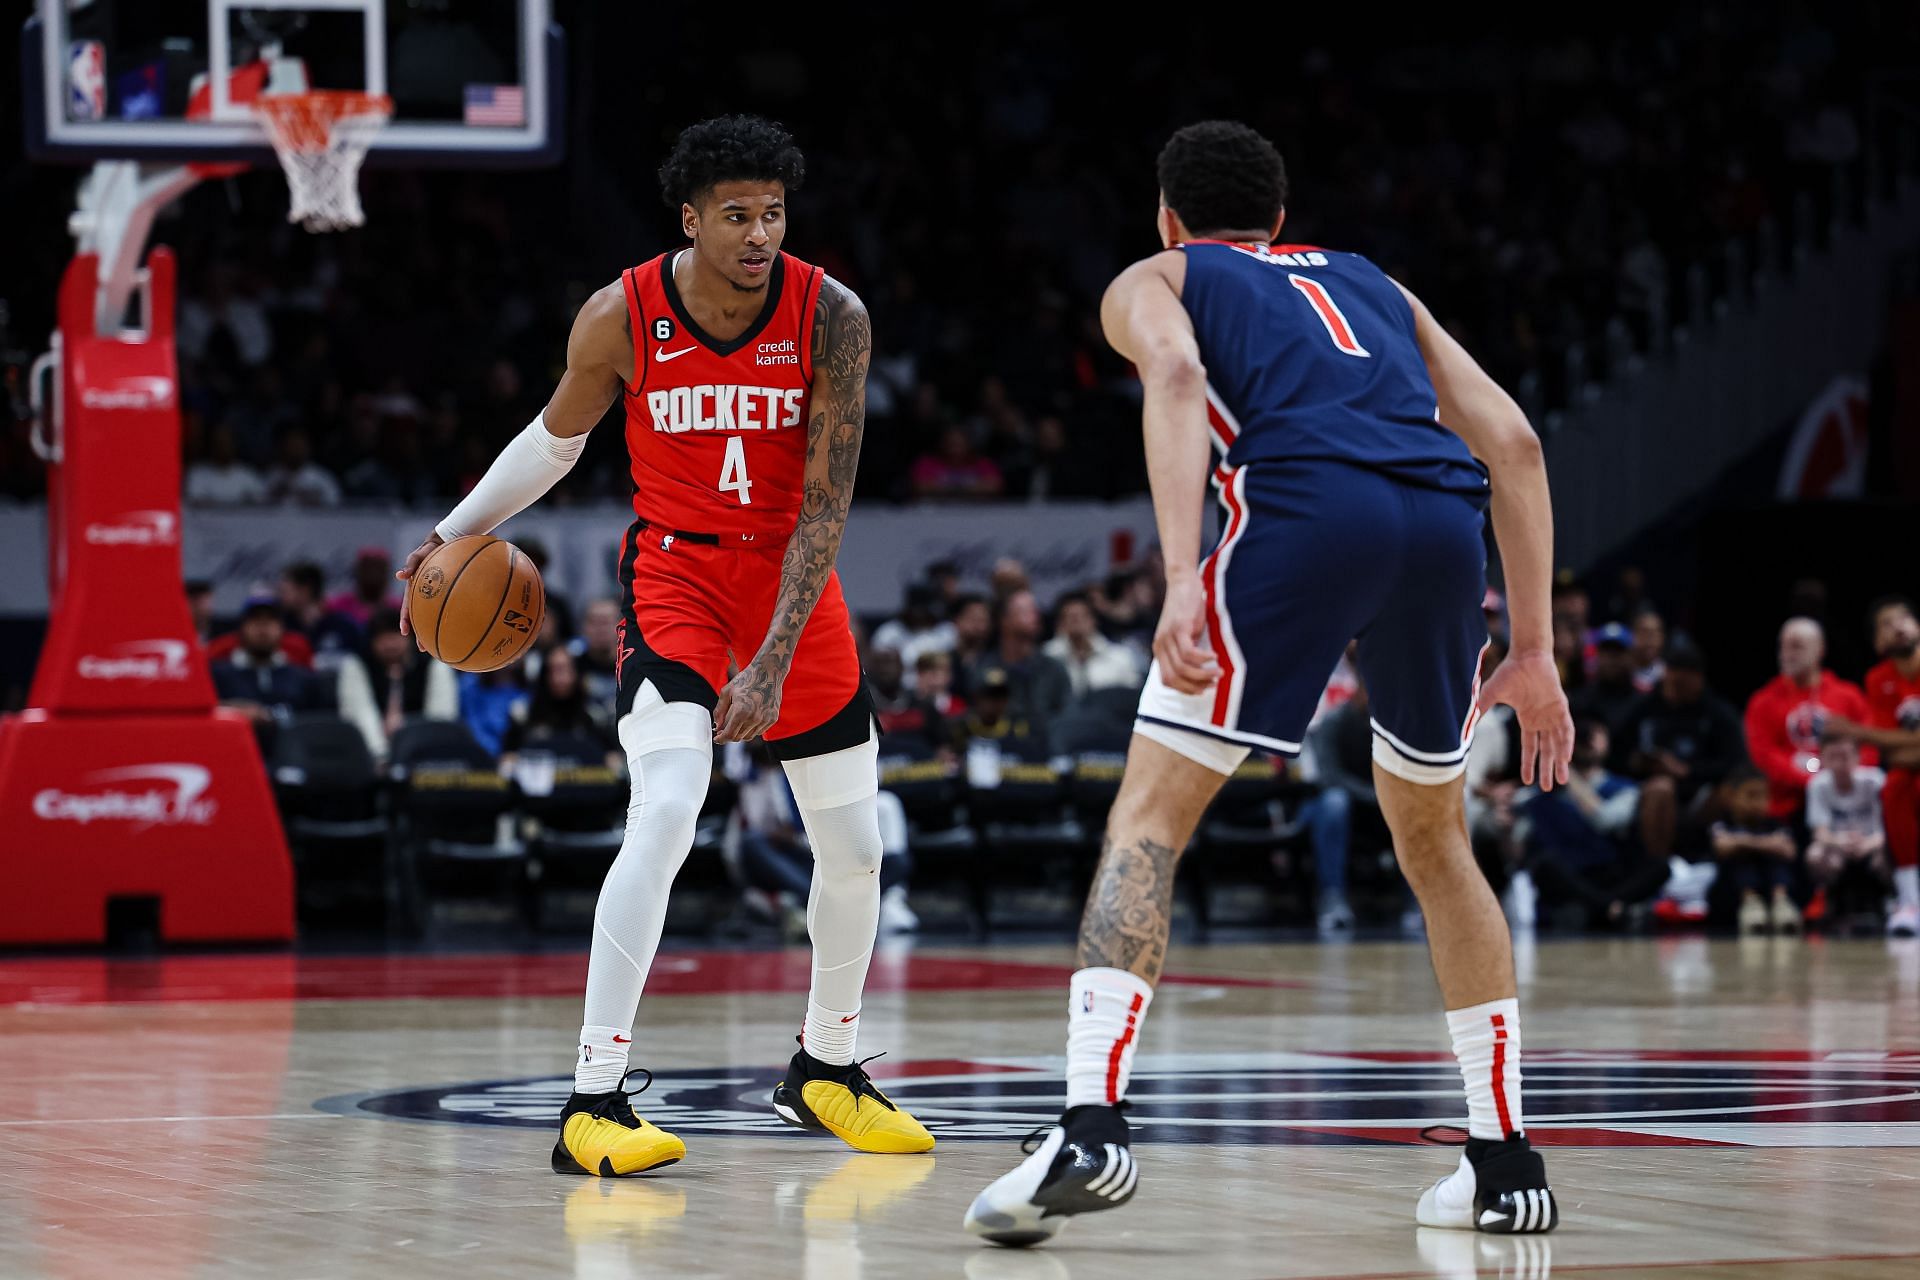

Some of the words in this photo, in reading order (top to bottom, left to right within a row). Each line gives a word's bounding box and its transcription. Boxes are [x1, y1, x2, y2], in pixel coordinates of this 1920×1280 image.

[656, 320, 670, 339] 6
[1287, 273, 1371, 358] 1
[756, 353, 798, 366] karma
[758, 339, 795, 353] credit
[647, 384, 803, 434] ROCKETS
[718, 435, 753, 505] 4
